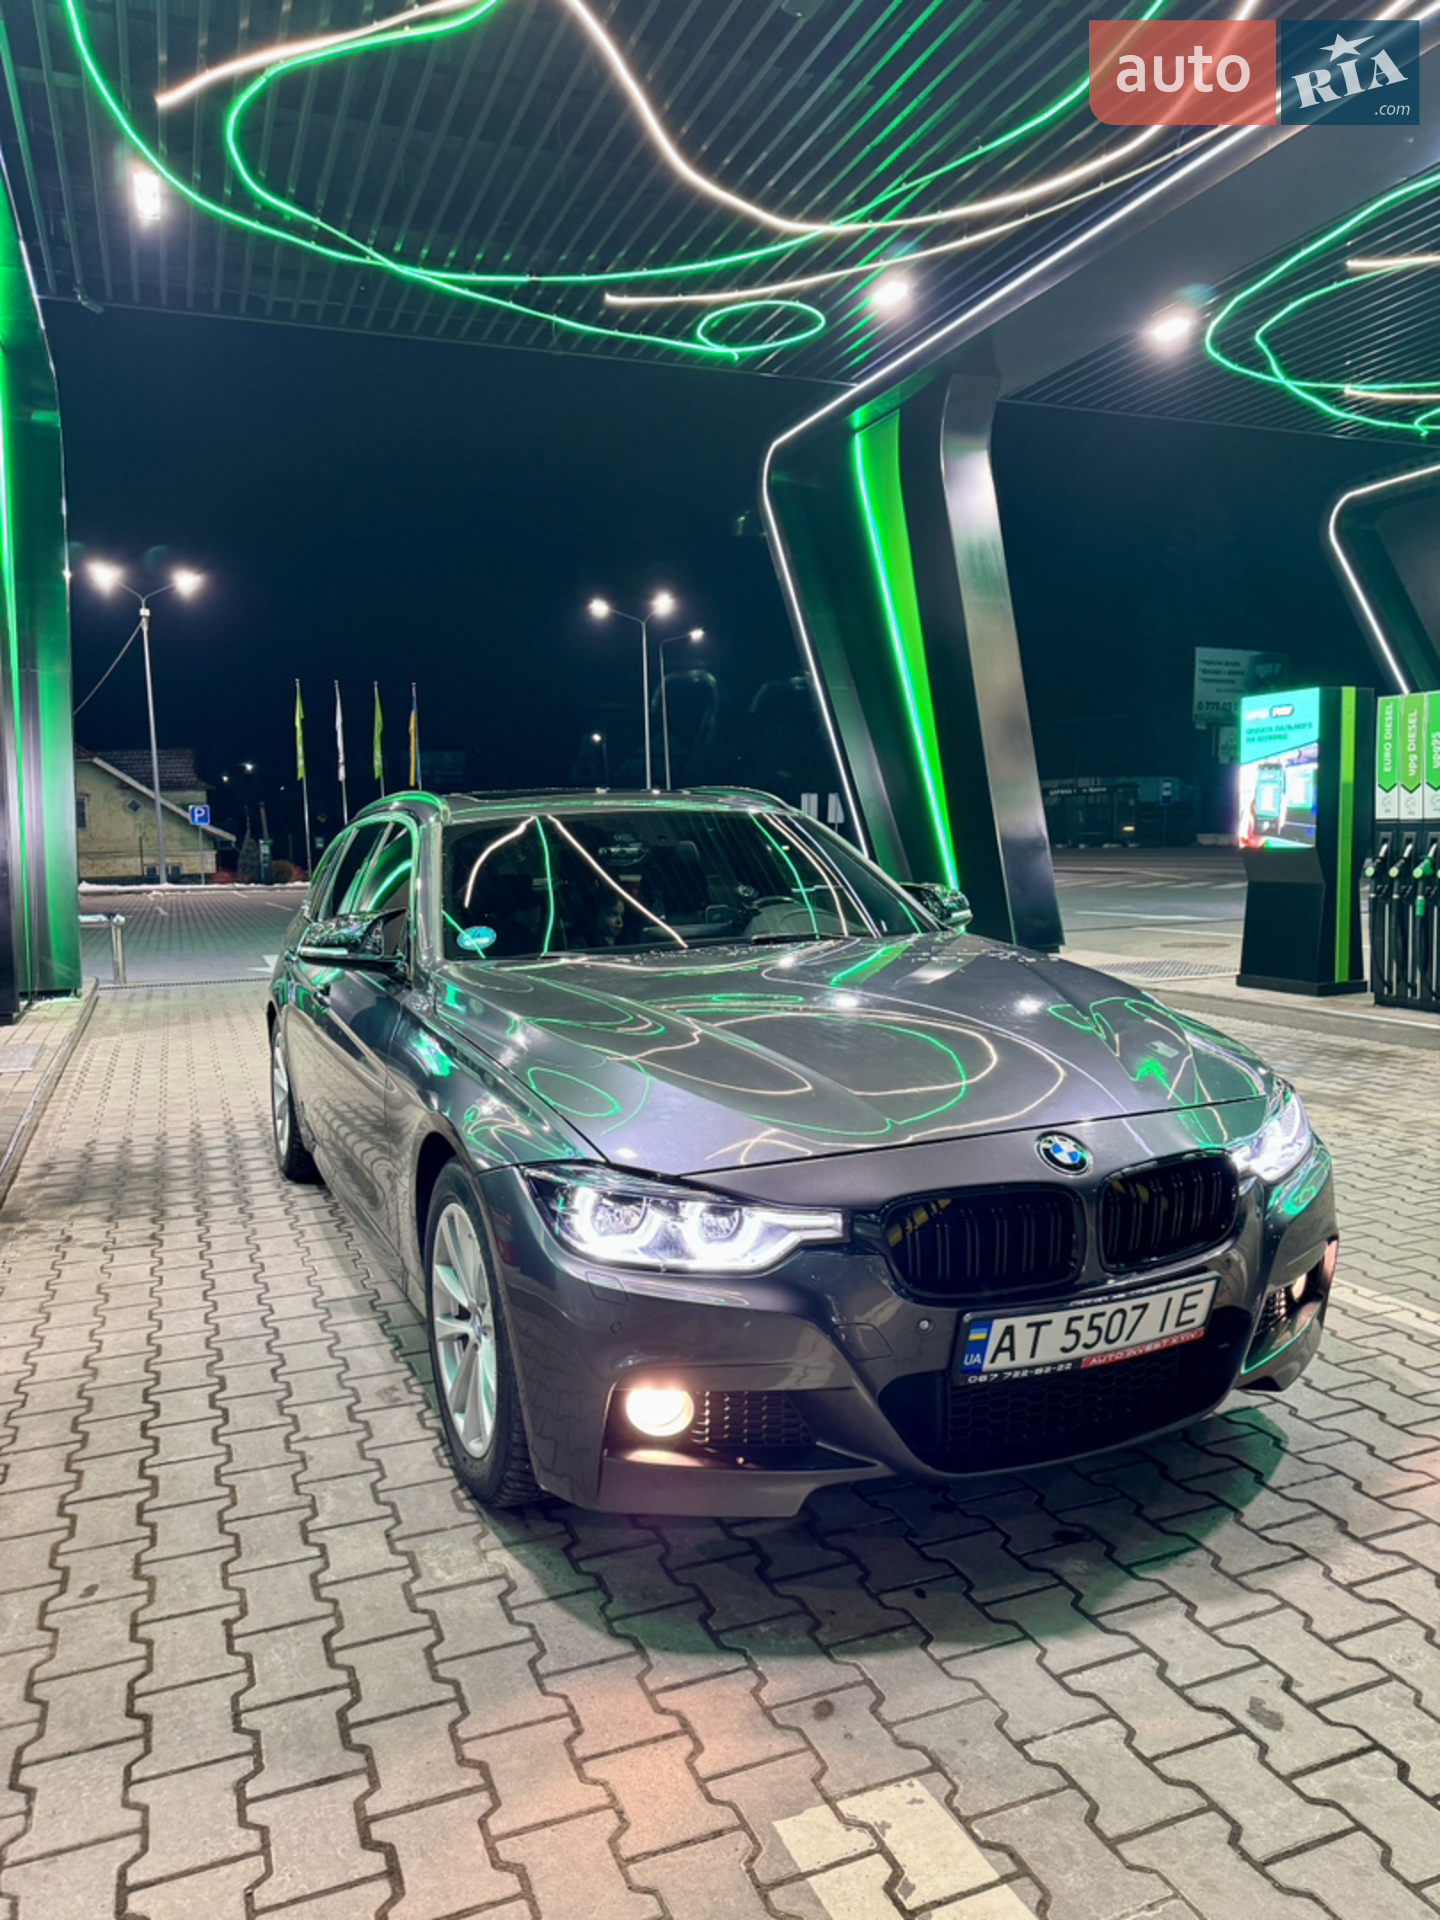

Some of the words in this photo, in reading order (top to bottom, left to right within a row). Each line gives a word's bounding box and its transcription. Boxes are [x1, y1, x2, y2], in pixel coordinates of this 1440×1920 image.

[1384, 703, 1394, 740] DIESEL
[1407, 709, 1418, 751] DIESEL
[1383, 743, 1392, 772] EURO
[1408, 753, 1419, 776] upg
[194, 807, 205, 822] P
[989, 1320, 1053, 1364] AT
[1060, 1303, 1149, 1354] 5507
[1159, 1288, 1204, 1333] IE
[964, 1353, 982, 1366] UA
[1090, 1352, 1124, 1365] AUTO
[967, 1373, 998, 1384] 067
